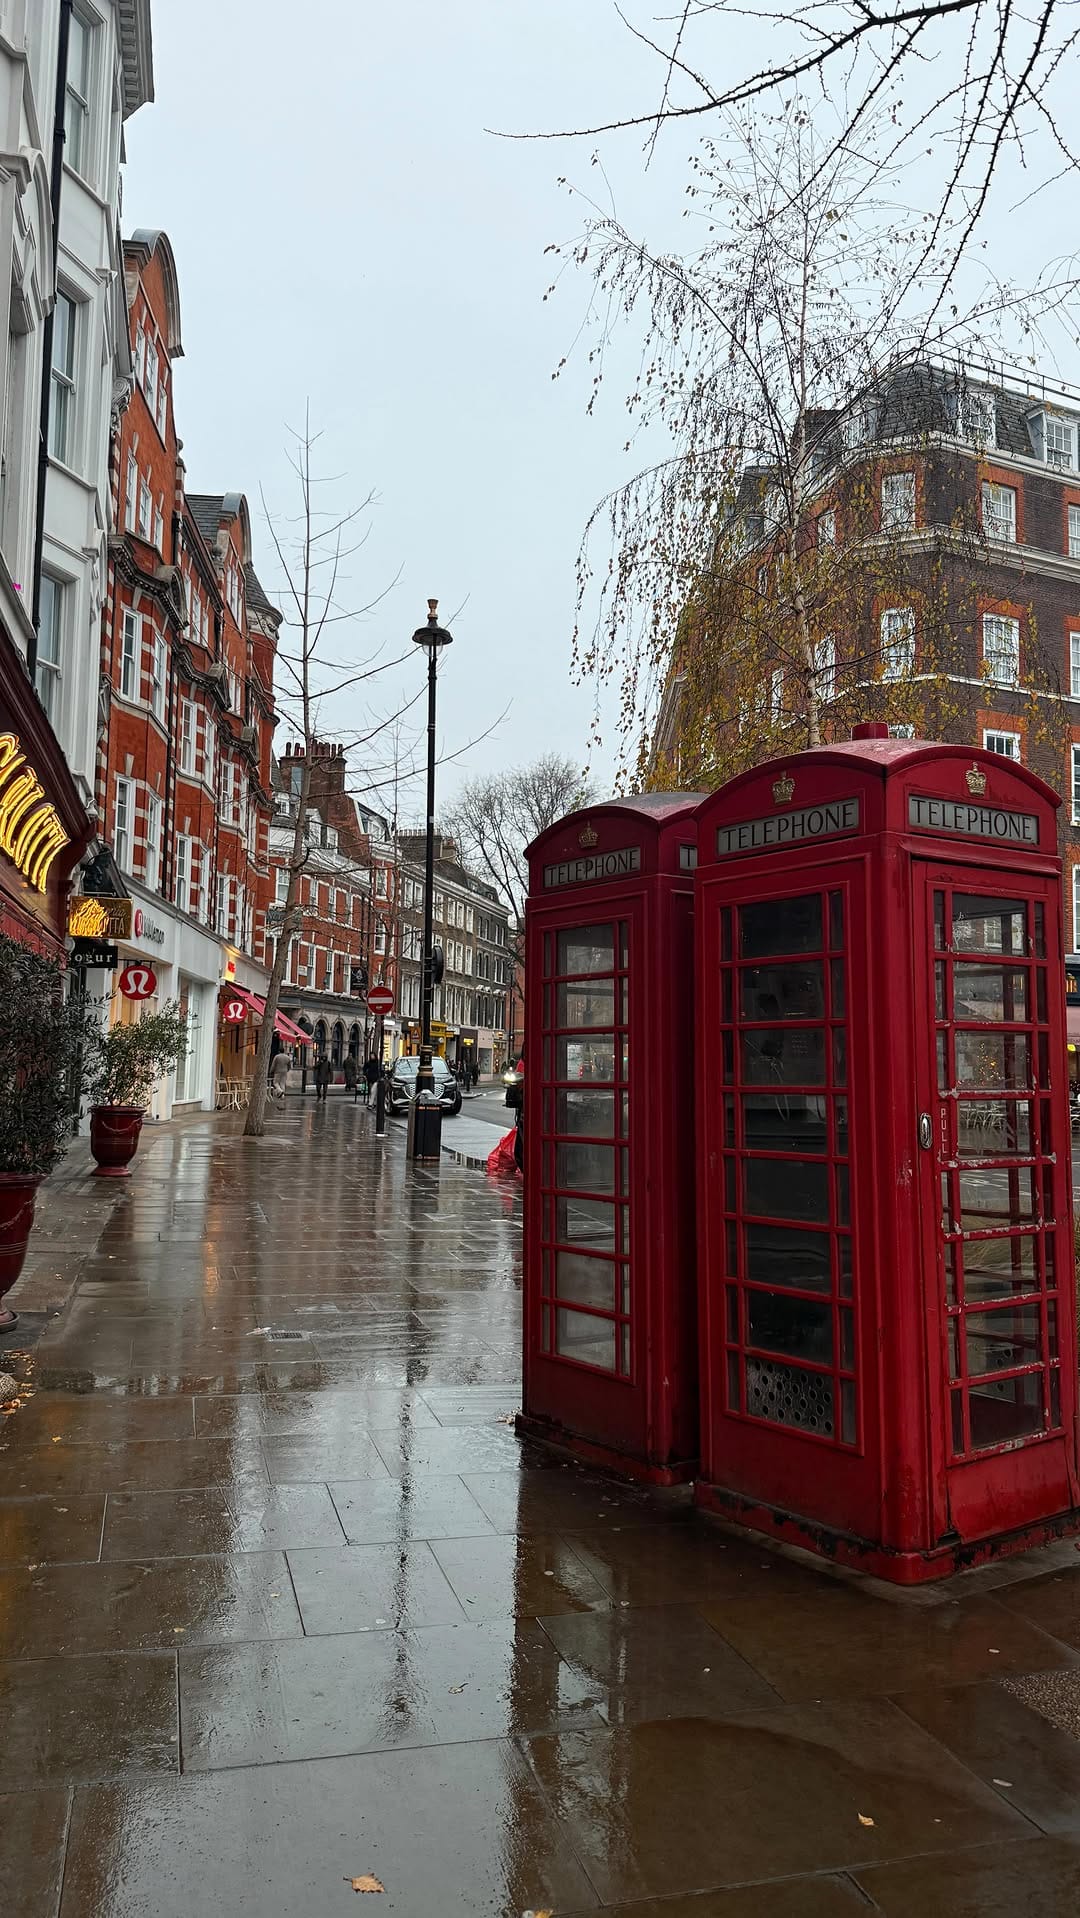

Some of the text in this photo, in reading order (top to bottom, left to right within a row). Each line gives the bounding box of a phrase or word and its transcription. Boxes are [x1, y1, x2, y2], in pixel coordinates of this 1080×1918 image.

[723, 802, 855, 851] TELEPHONE
[912, 799, 1032, 840] TELEPHONE
[548, 850, 639, 886] TELEPHONE
[940, 1108, 948, 1154] PULL
